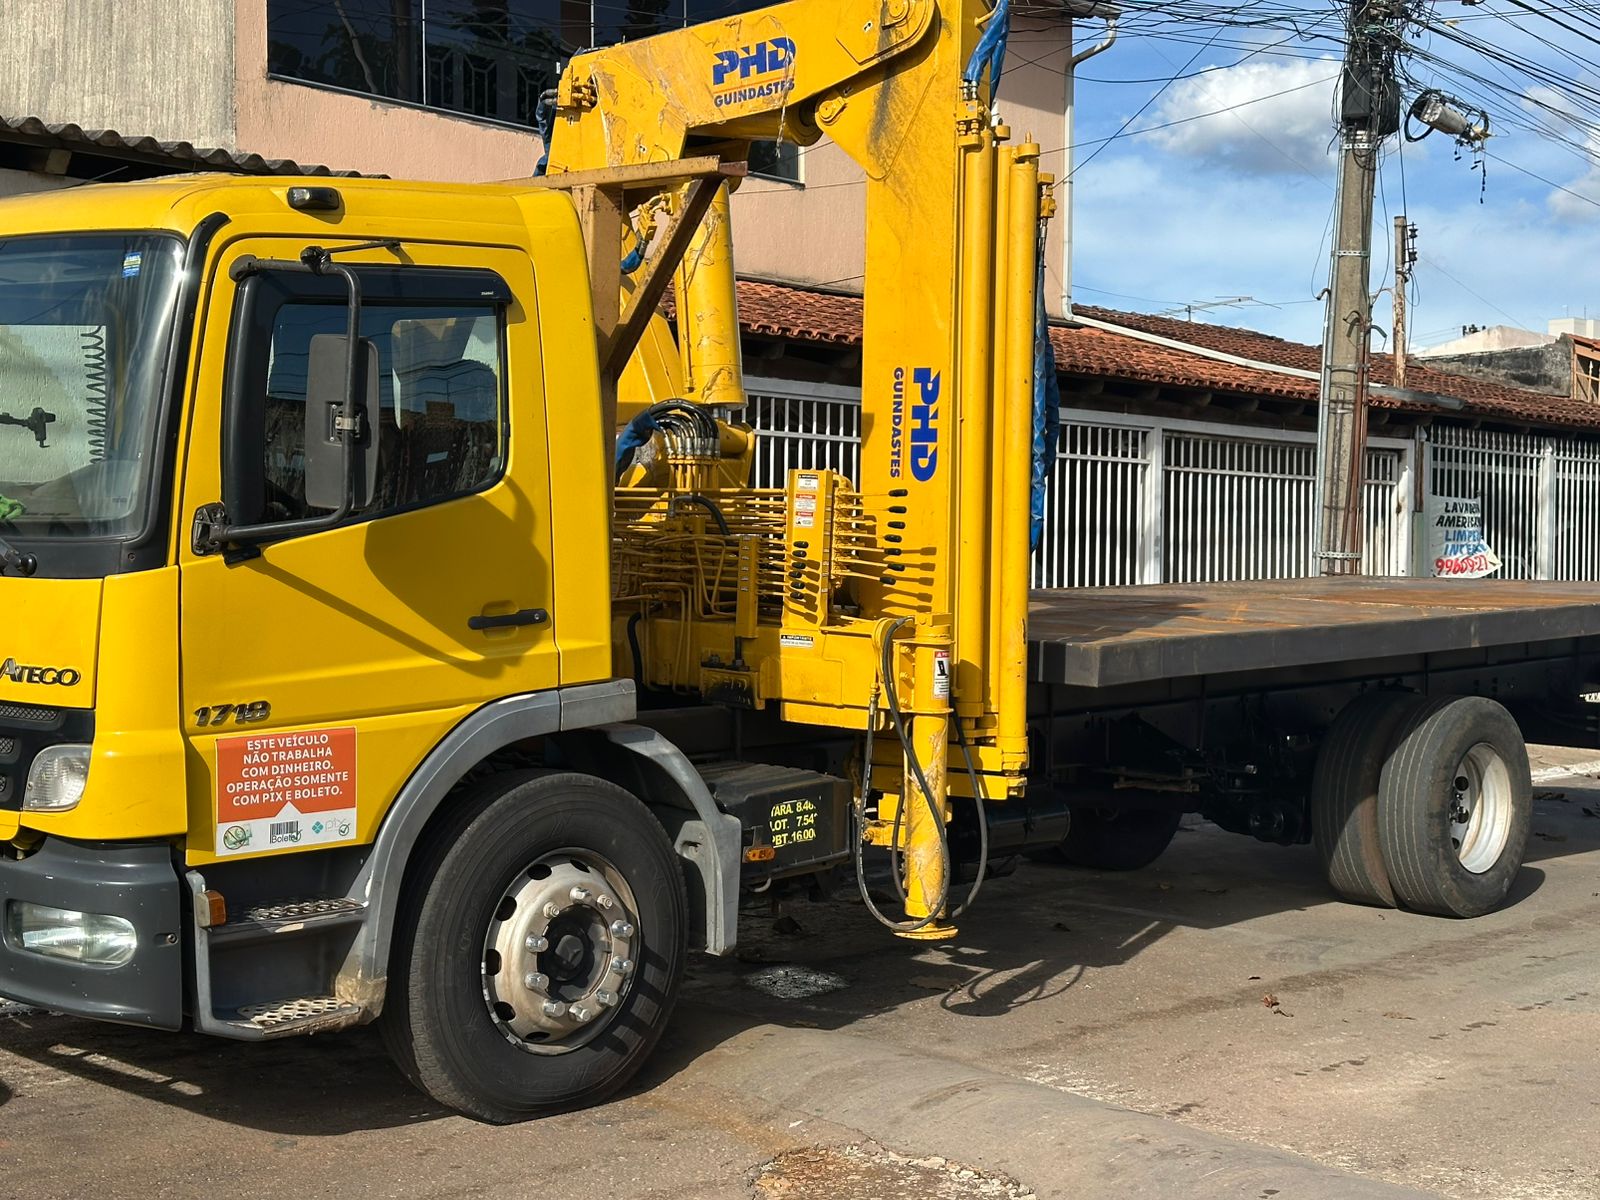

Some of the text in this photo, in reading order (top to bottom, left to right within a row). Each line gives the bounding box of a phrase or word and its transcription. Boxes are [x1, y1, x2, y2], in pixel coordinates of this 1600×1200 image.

[713, 37, 796, 85] PHD
[714, 78, 795, 107] GUINDASTES
[889, 367, 904, 478] GUINDASTES
[910, 367, 940, 482] PHD
[194, 700, 272, 727] 1718
[247, 733, 329, 750] ESTE VEÍCULO
[243, 747, 333, 764] NÃO TRABALHA
[241, 760, 334, 778] COM DINHEIRO.
[226, 771, 349, 793] OPERAÇÃO SOMENTE
[232, 785, 342, 806] COM PIX E BOLETO.
[796, 813, 818, 826] 7.54
